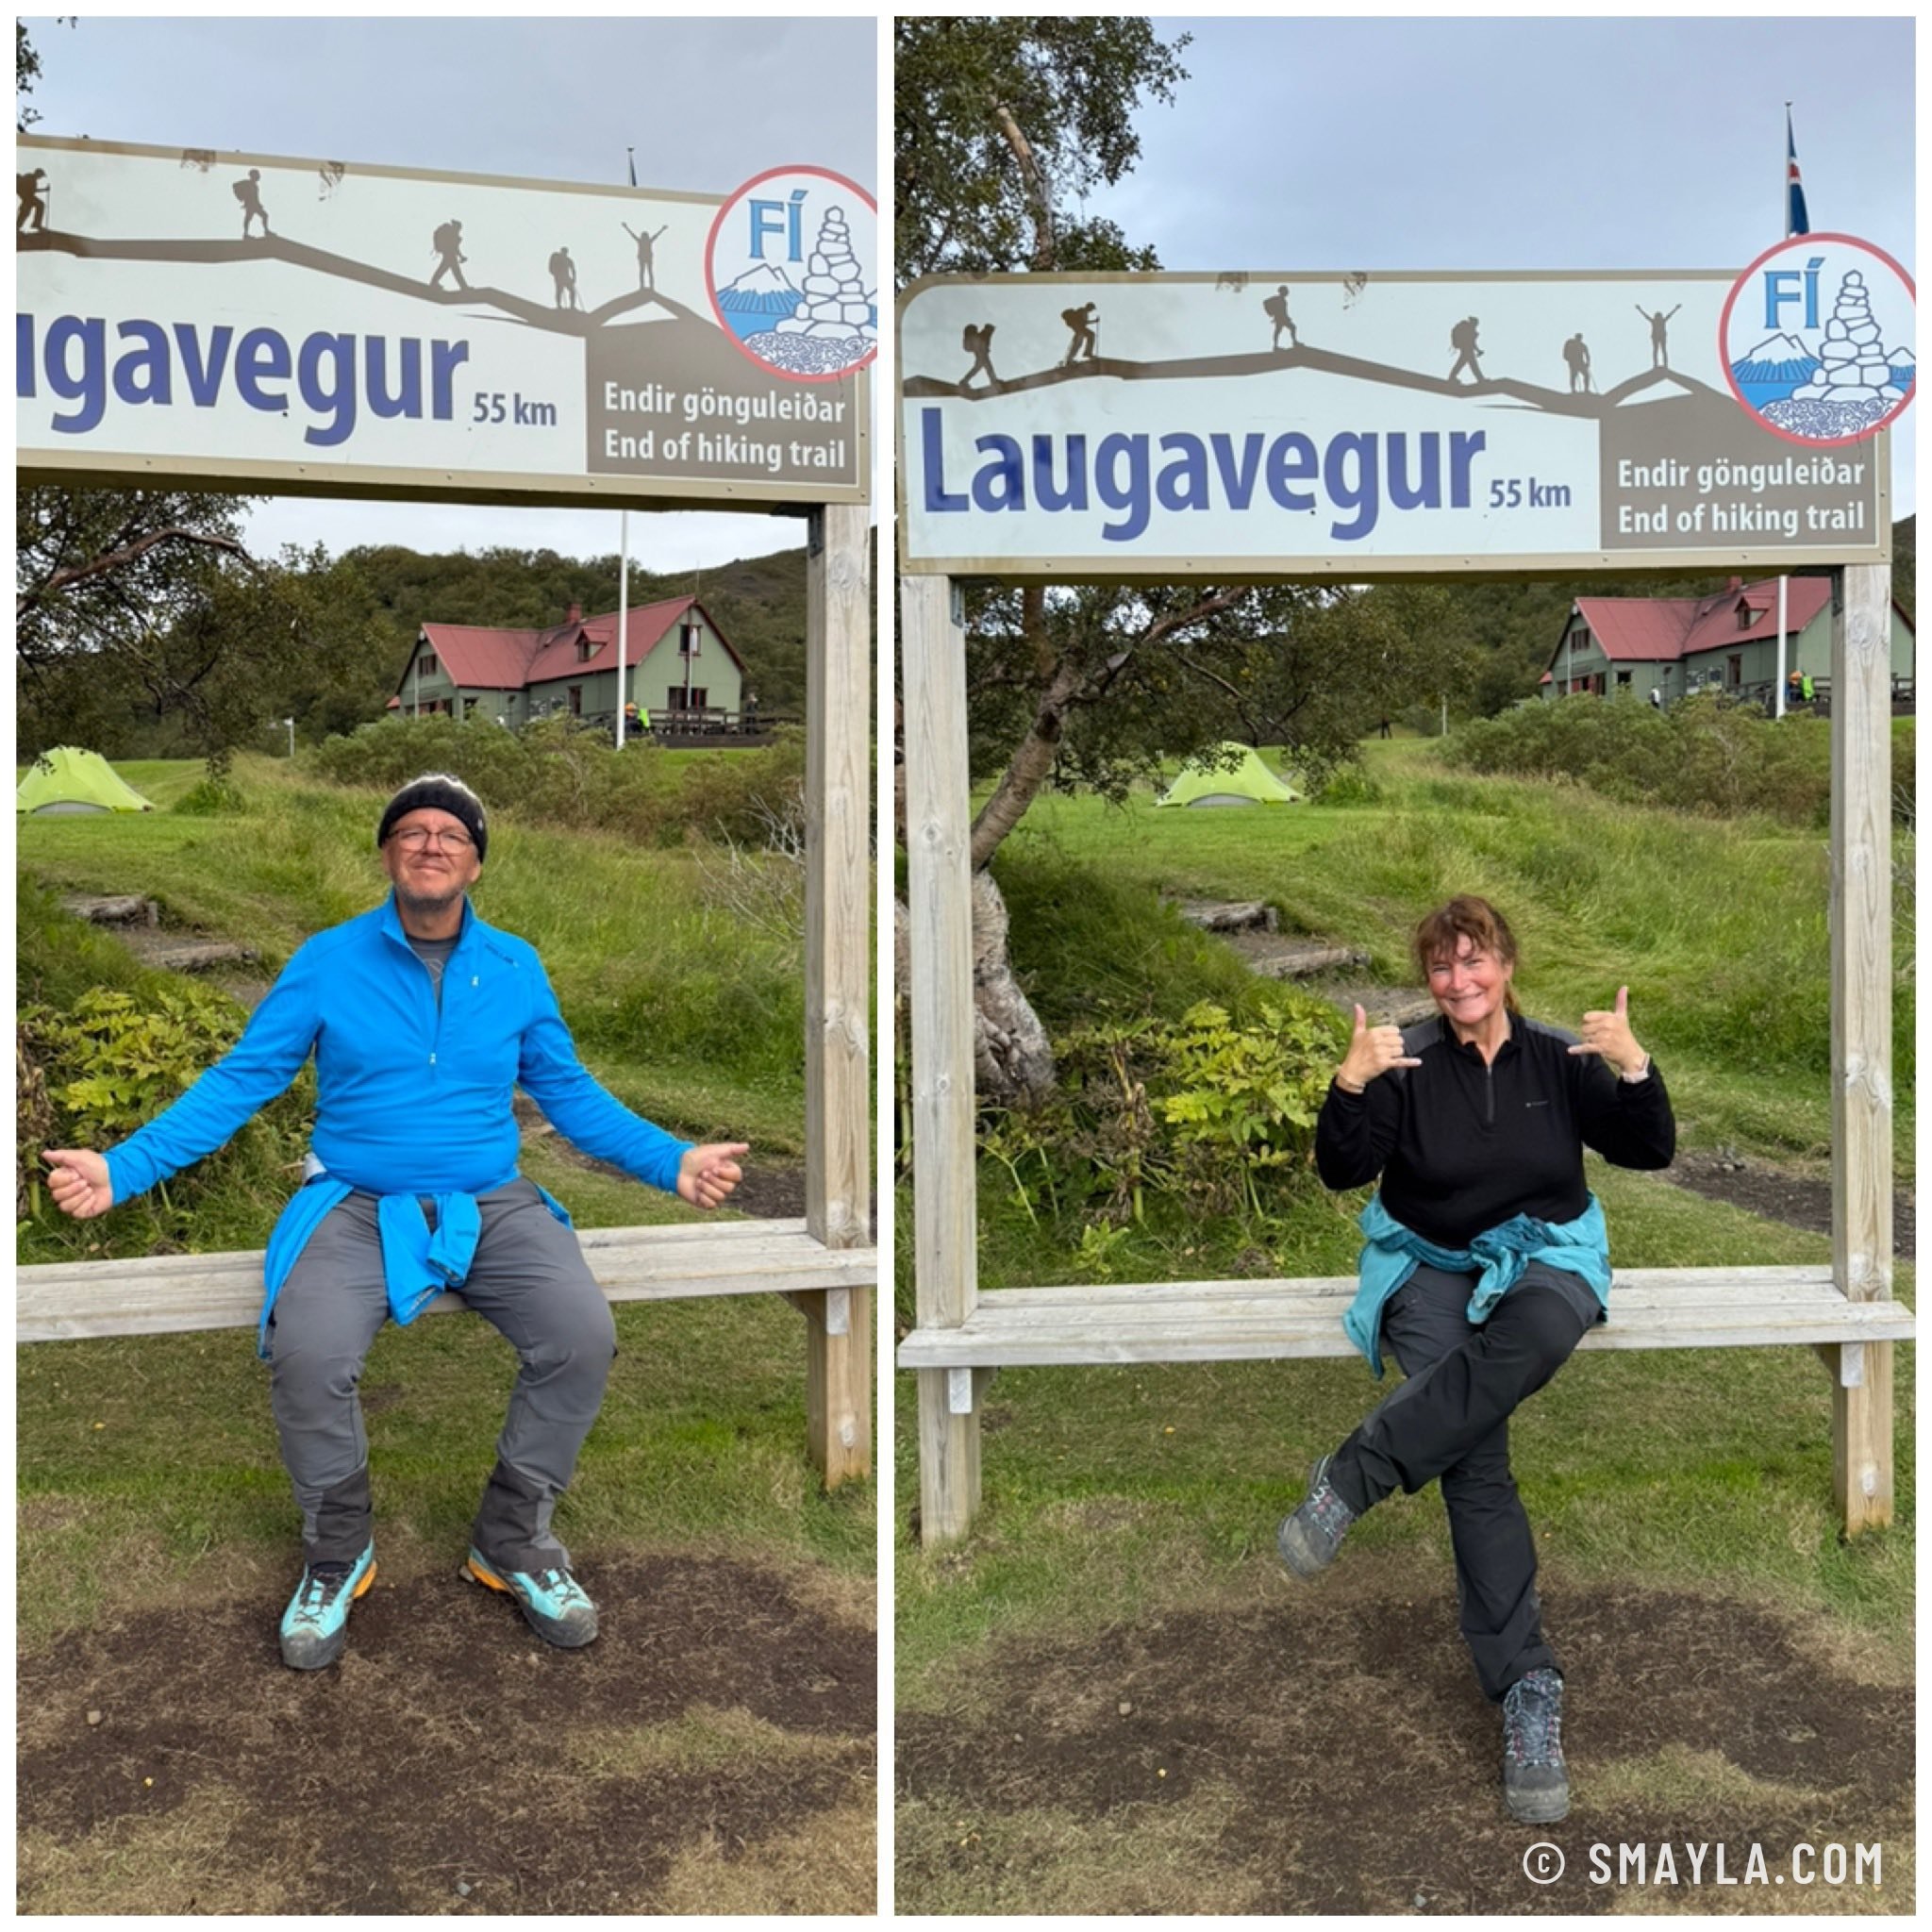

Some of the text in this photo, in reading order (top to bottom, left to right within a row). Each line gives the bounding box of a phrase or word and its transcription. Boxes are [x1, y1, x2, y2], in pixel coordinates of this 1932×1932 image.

[748, 190, 808, 262] FÍ
[1764, 257, 1825, 329] FÍ
[474, 392, 506, 423] 55
[513, 392, 557, 425] km
[605, 381, 845, 425] Endir gönguleiðar
[605, 429, 845, 472] End of hiking trail
[922, 407, 1571, 541] Laugavegur 55 km
[1618, 457, 1865, 493] Endir gönguleiðar
[1619, 502, 1864, 537] End of hiking trail
